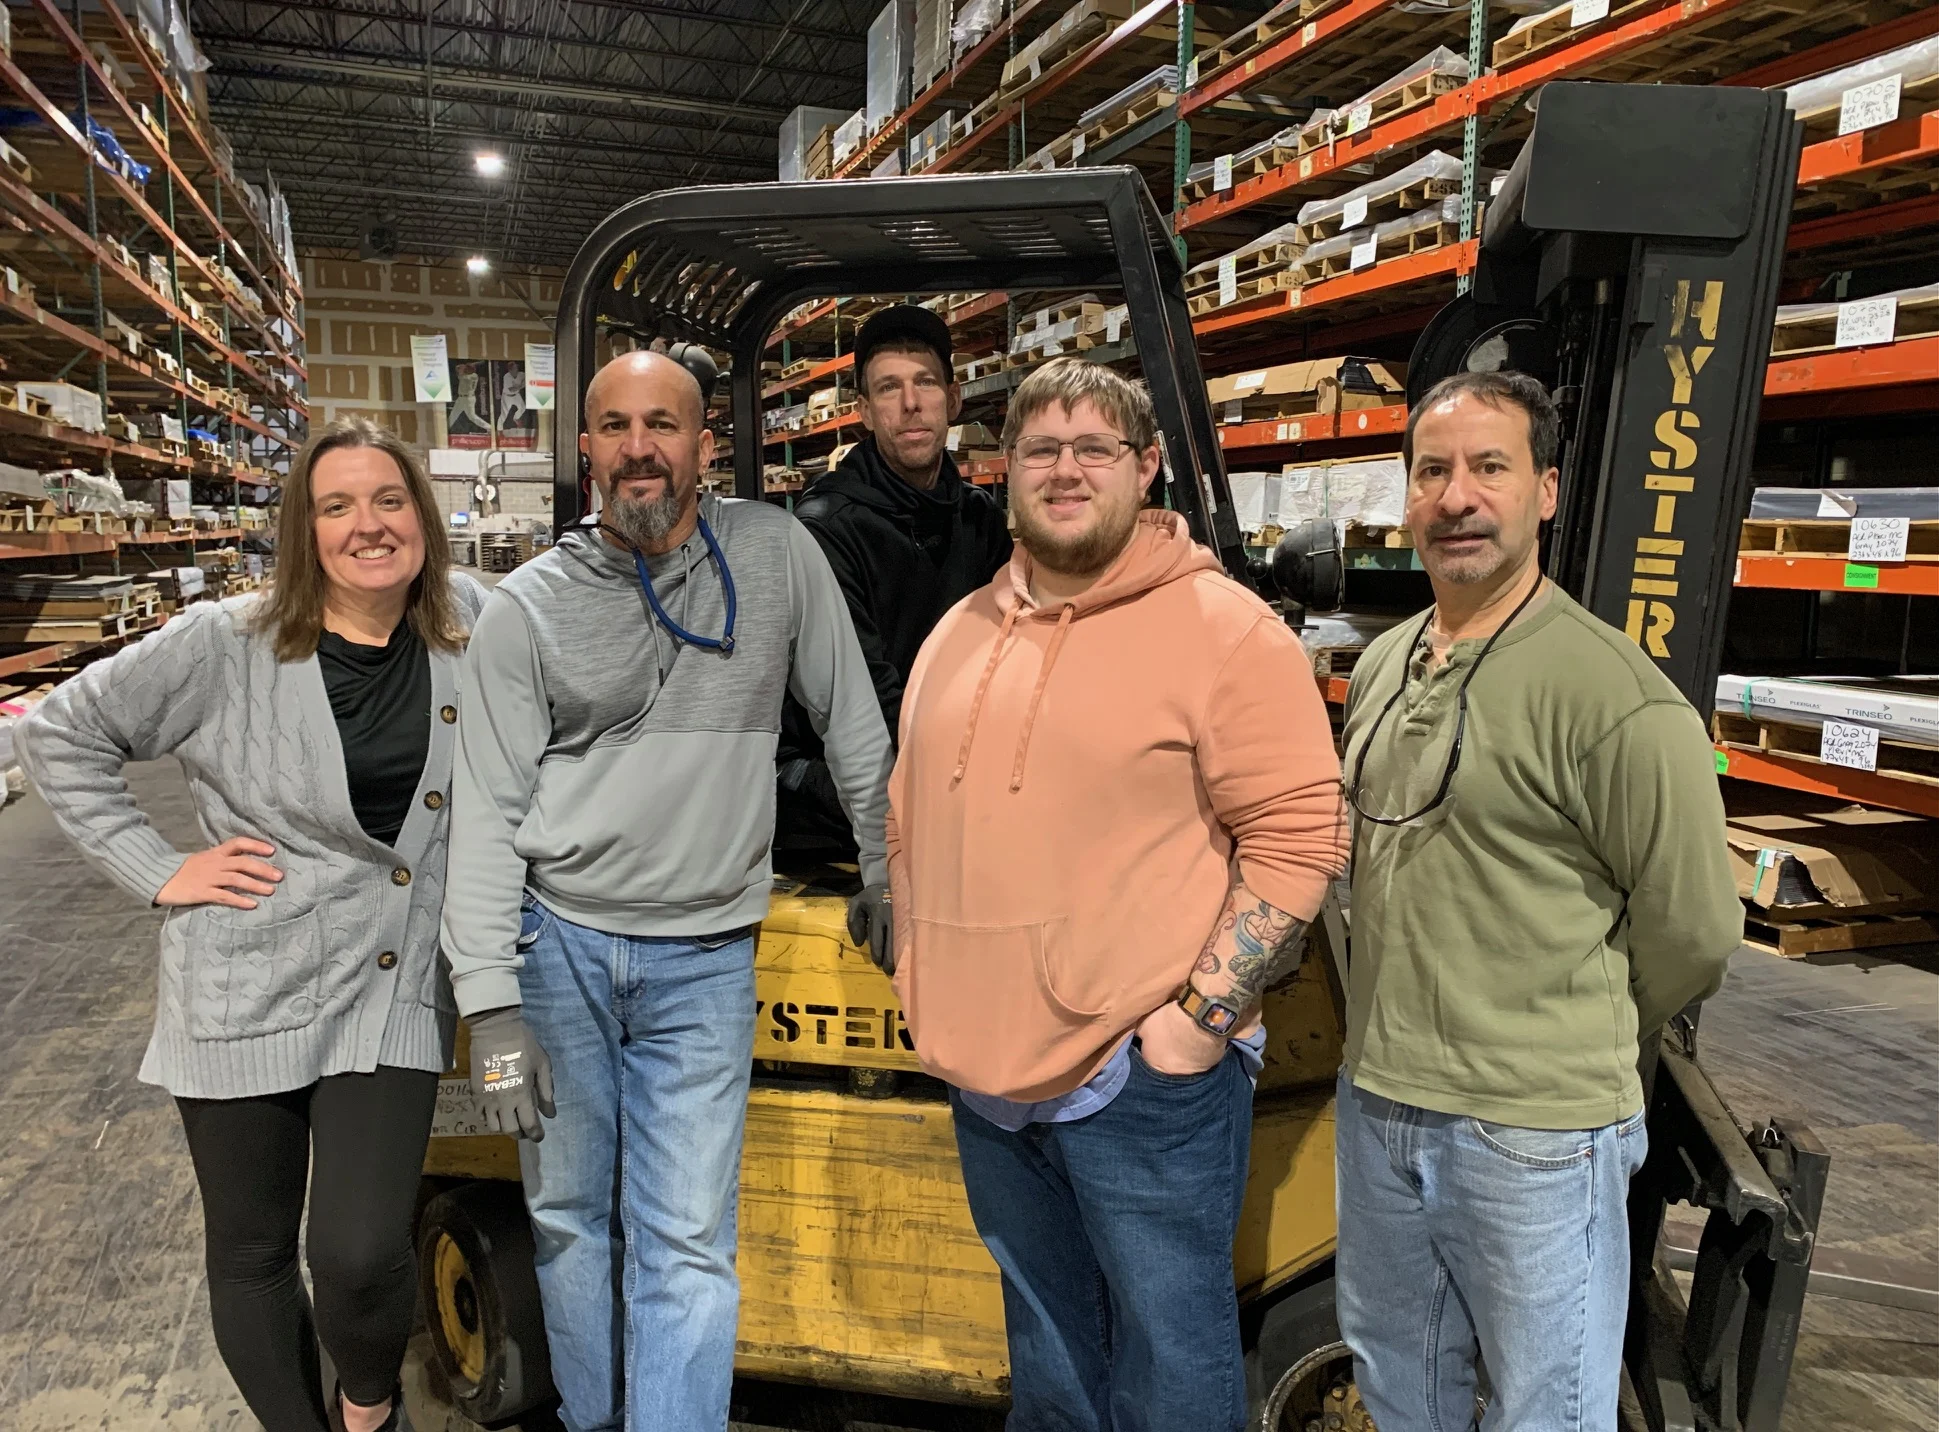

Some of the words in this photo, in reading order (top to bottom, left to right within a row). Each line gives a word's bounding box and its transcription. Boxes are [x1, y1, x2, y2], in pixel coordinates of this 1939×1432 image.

[1624, 279, 1724, 659] HYSTER
[1855, 518, 1901, 531] 10630
[1736, 693, 1776, 704] TNSEO
[1845, 708, 1893, 721] TRINSEO
[1825, 724, 1872, 743] 10624
